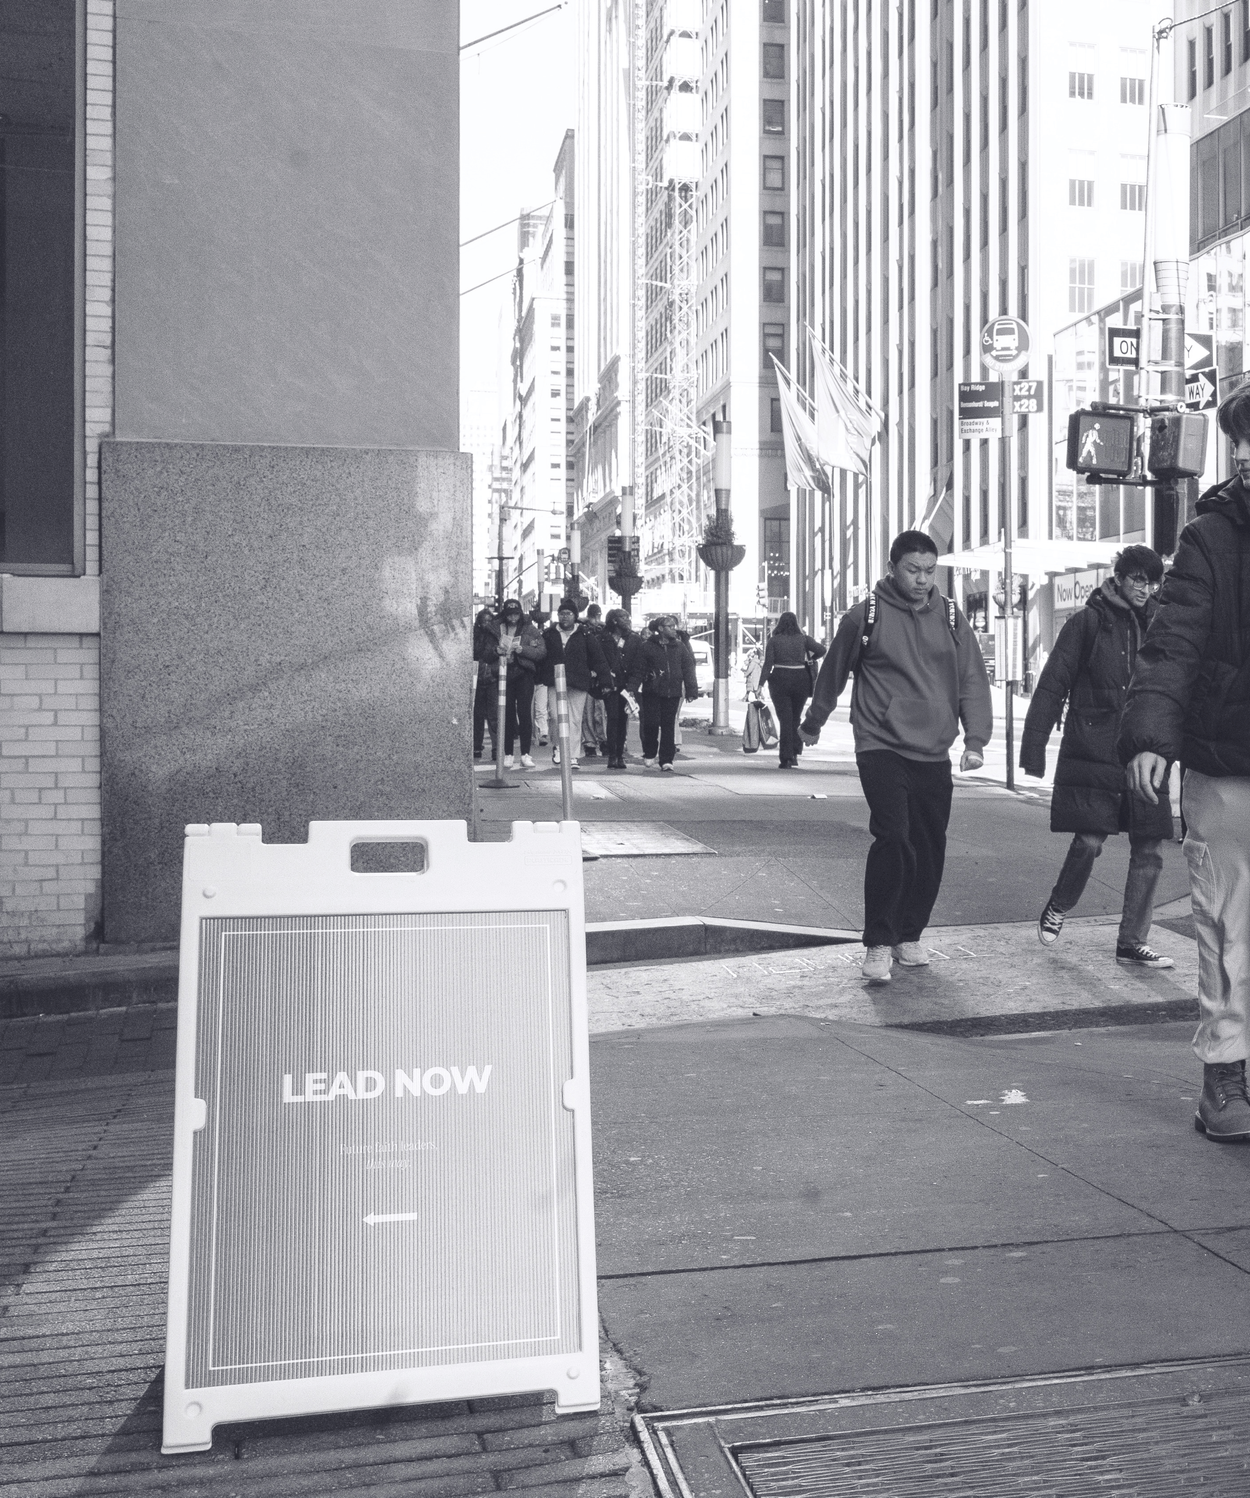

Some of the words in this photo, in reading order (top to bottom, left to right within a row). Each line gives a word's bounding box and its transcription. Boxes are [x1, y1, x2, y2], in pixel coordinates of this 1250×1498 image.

[971, 384, 986, 392] Ridge
[1013, 382, 1037, 395] x27
[1188, 383, 1205, 400] WAY
[1013, 399, 1037, 412] x28
[1057, 583, 1073, 602] Now
[1074, 581, 1093, 604] Open
[283, 1070, 386, 1103] LEAD
[395, 1065, 493, 1097] NOW
[340, 1143, 373, 1154] Future
[375, 1141, 398, 1153] faith
